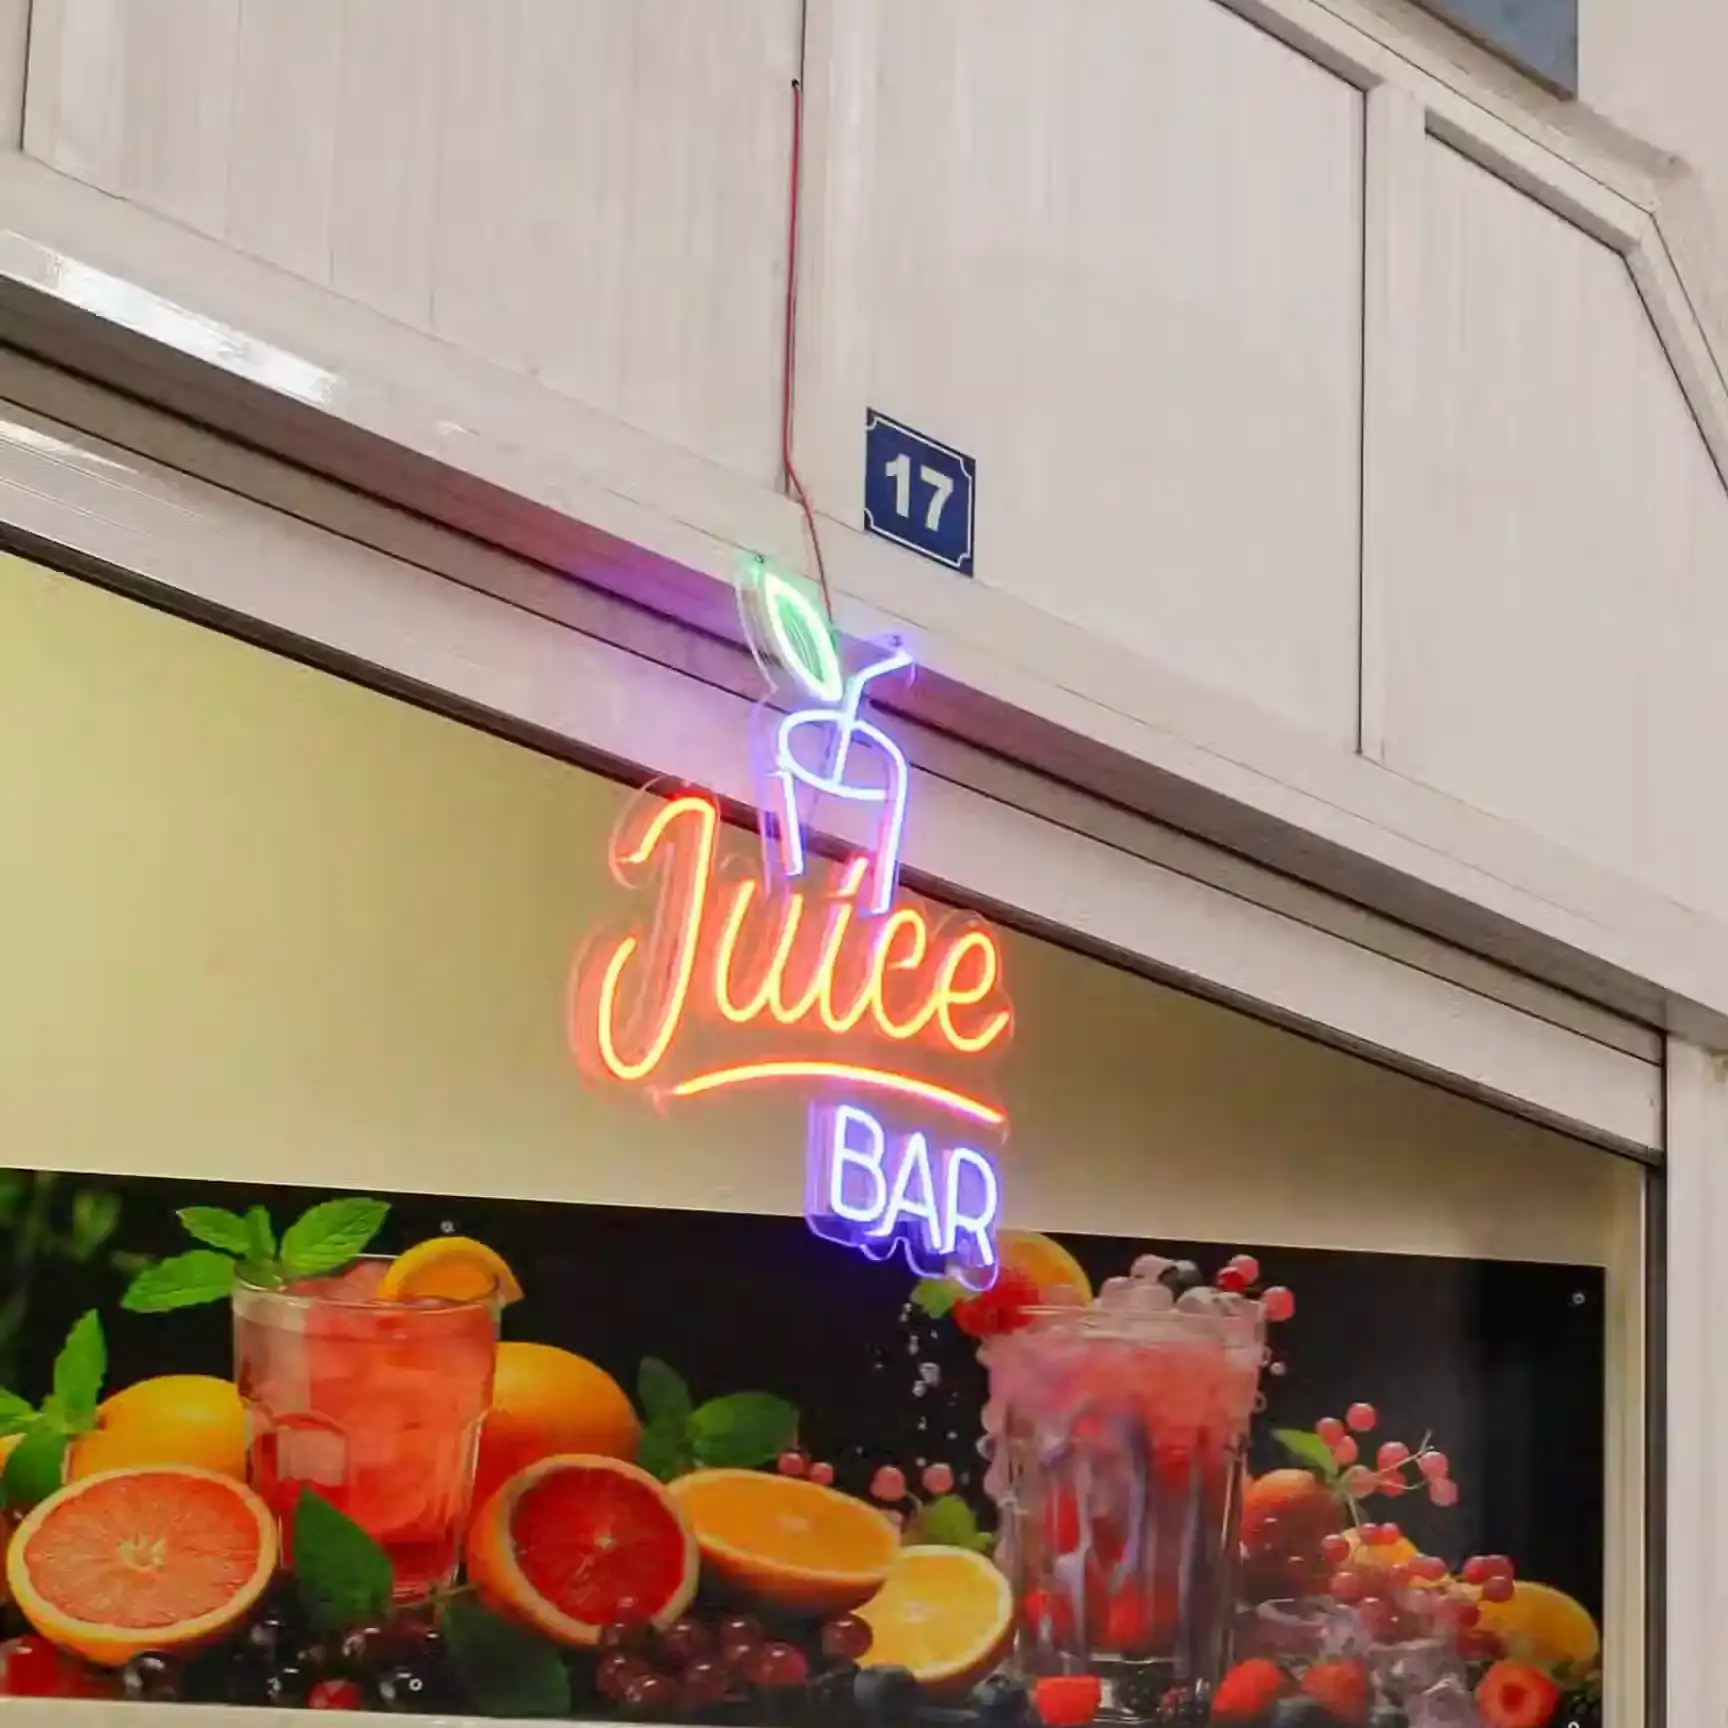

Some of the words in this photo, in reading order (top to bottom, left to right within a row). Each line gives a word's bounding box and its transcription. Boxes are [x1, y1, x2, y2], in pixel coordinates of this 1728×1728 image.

[886, 452, 954, 532] 17
[590, 795, 1012, 1081] Juice
[826, 1101, 999, 1268] BAR
